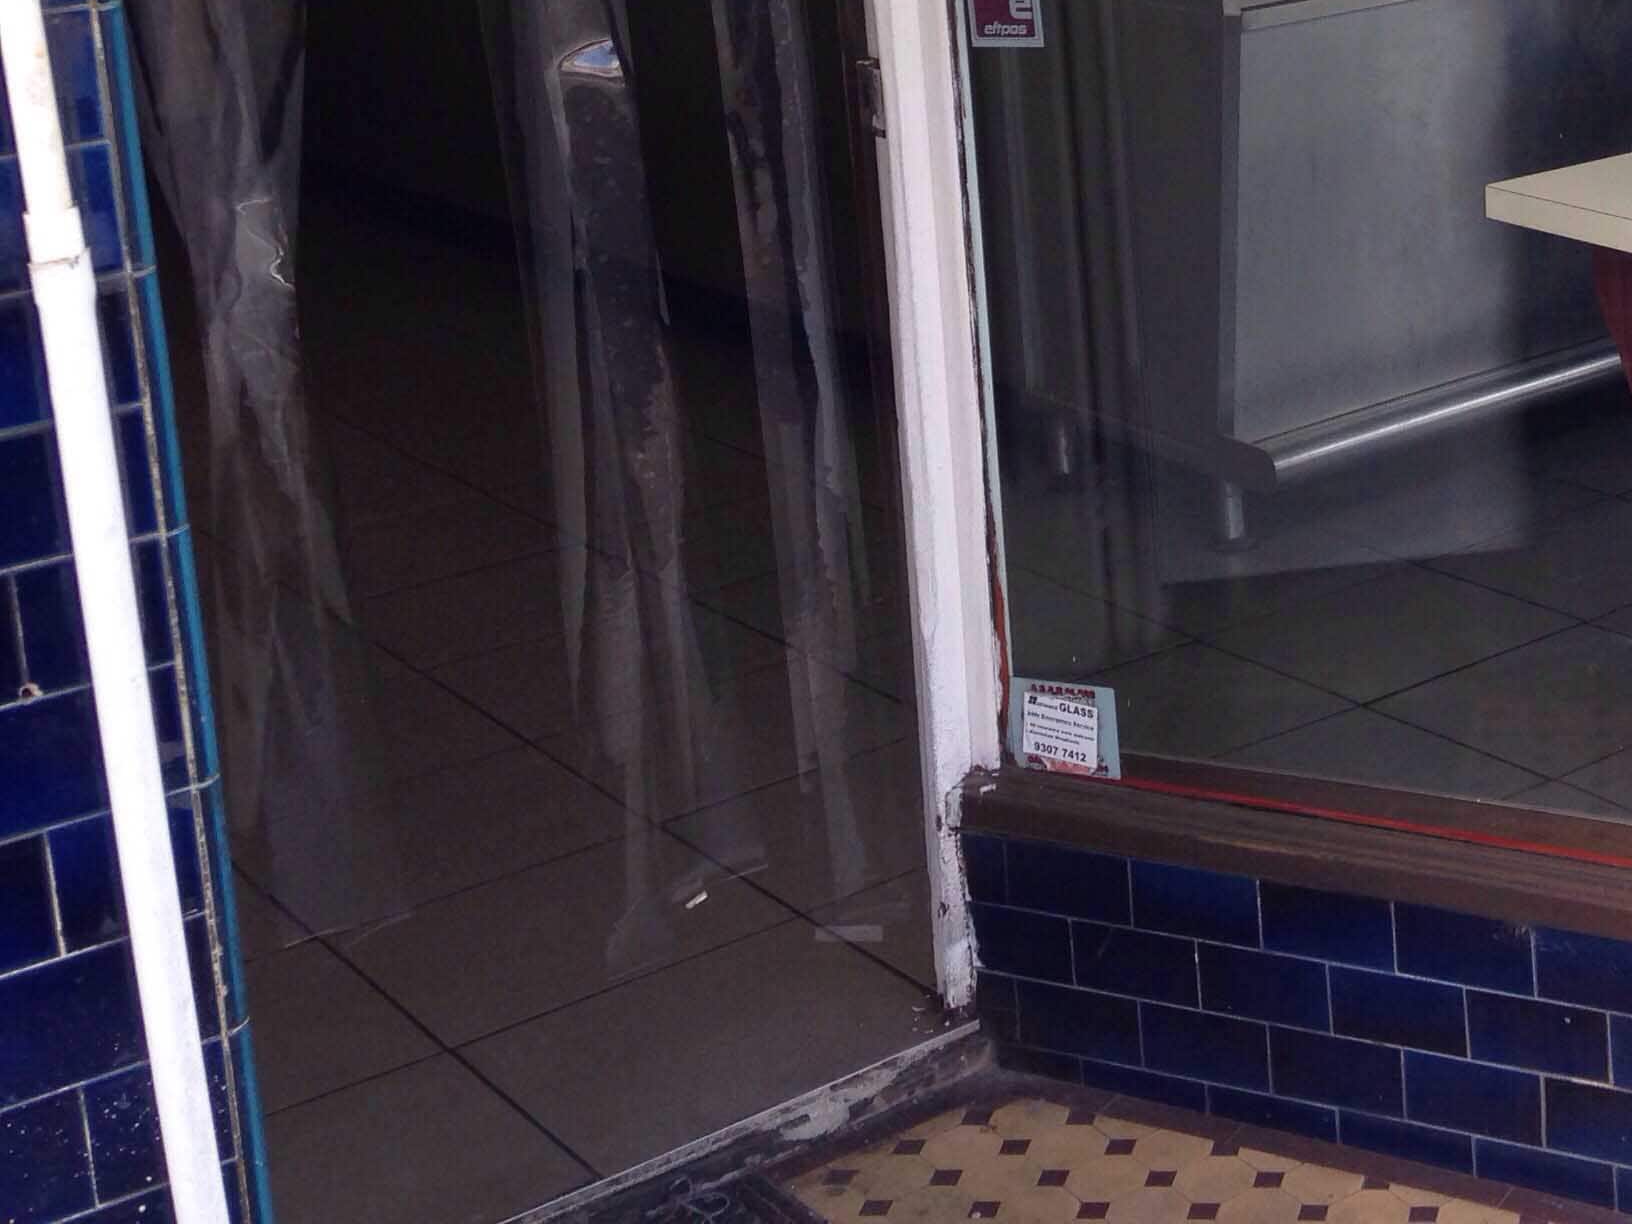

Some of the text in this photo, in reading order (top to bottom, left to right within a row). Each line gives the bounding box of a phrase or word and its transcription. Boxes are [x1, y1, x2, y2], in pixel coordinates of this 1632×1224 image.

[984, 21, 1027, 37] eftpos
[1059, 703, 1094, 719] GLASS
[1034, 742, 1087, 762] 9307 7412
